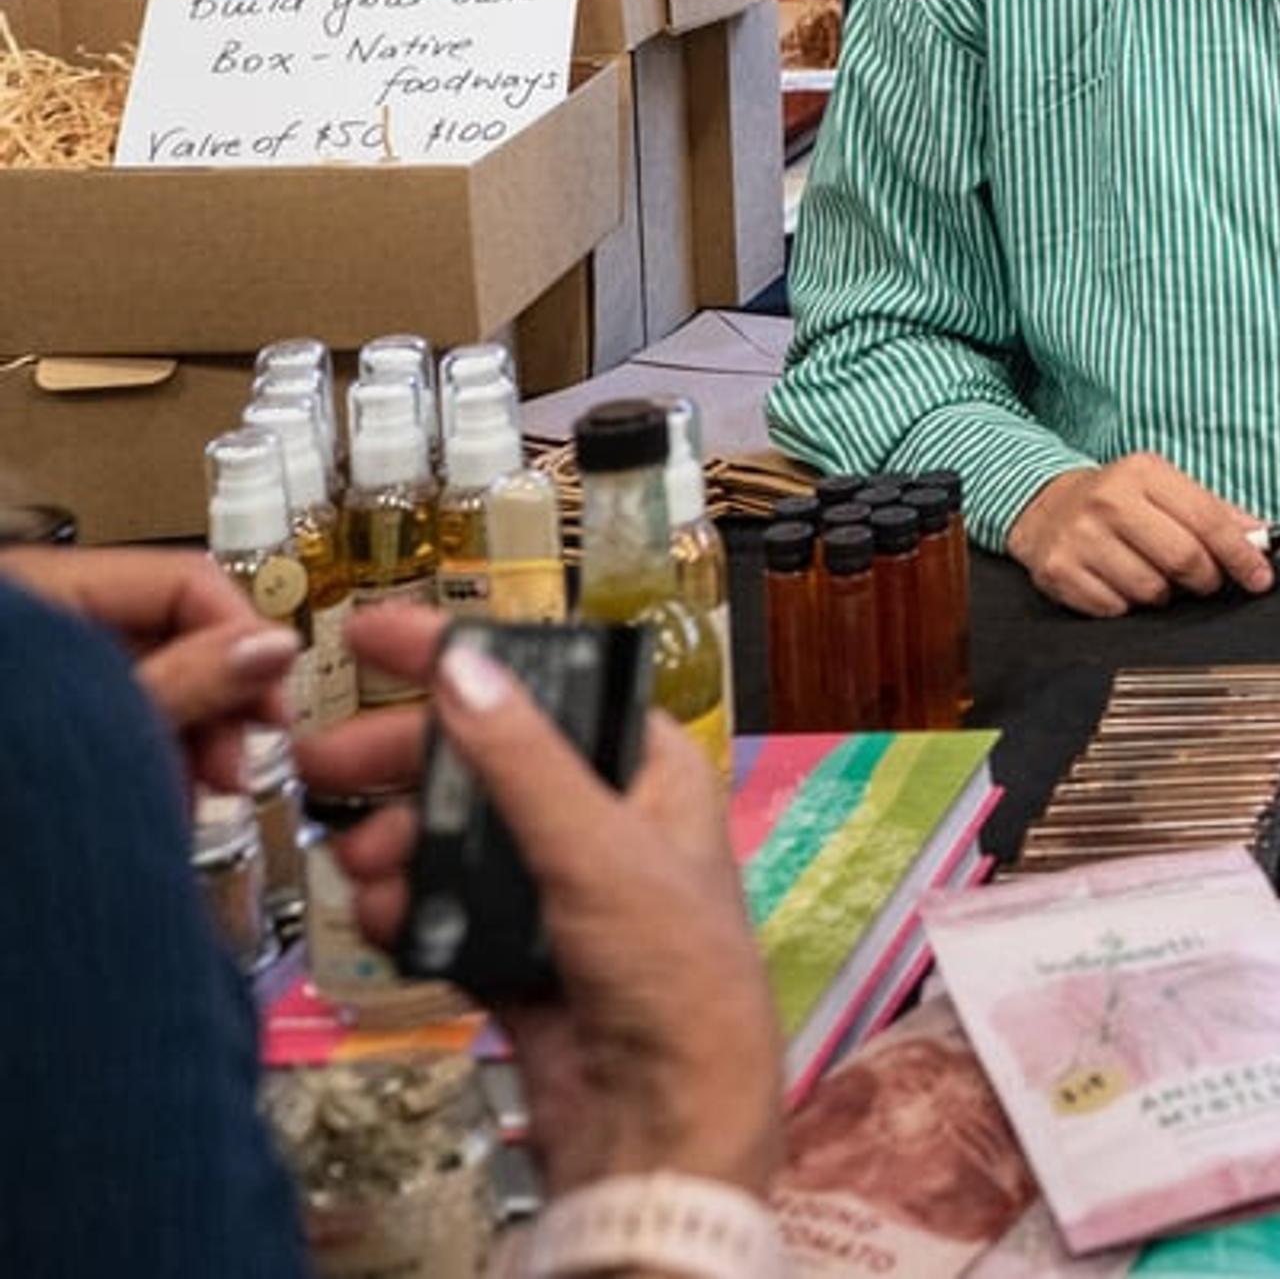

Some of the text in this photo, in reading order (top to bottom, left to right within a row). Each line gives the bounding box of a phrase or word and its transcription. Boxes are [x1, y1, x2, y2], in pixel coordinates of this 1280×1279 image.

[211, 40, 295, 74] Box
[346, 36, 474, 64] Native
[376, 68, 558, 108] foodways
[252, 122, 302, 157] of
[425, 120, 507, 152] $100
